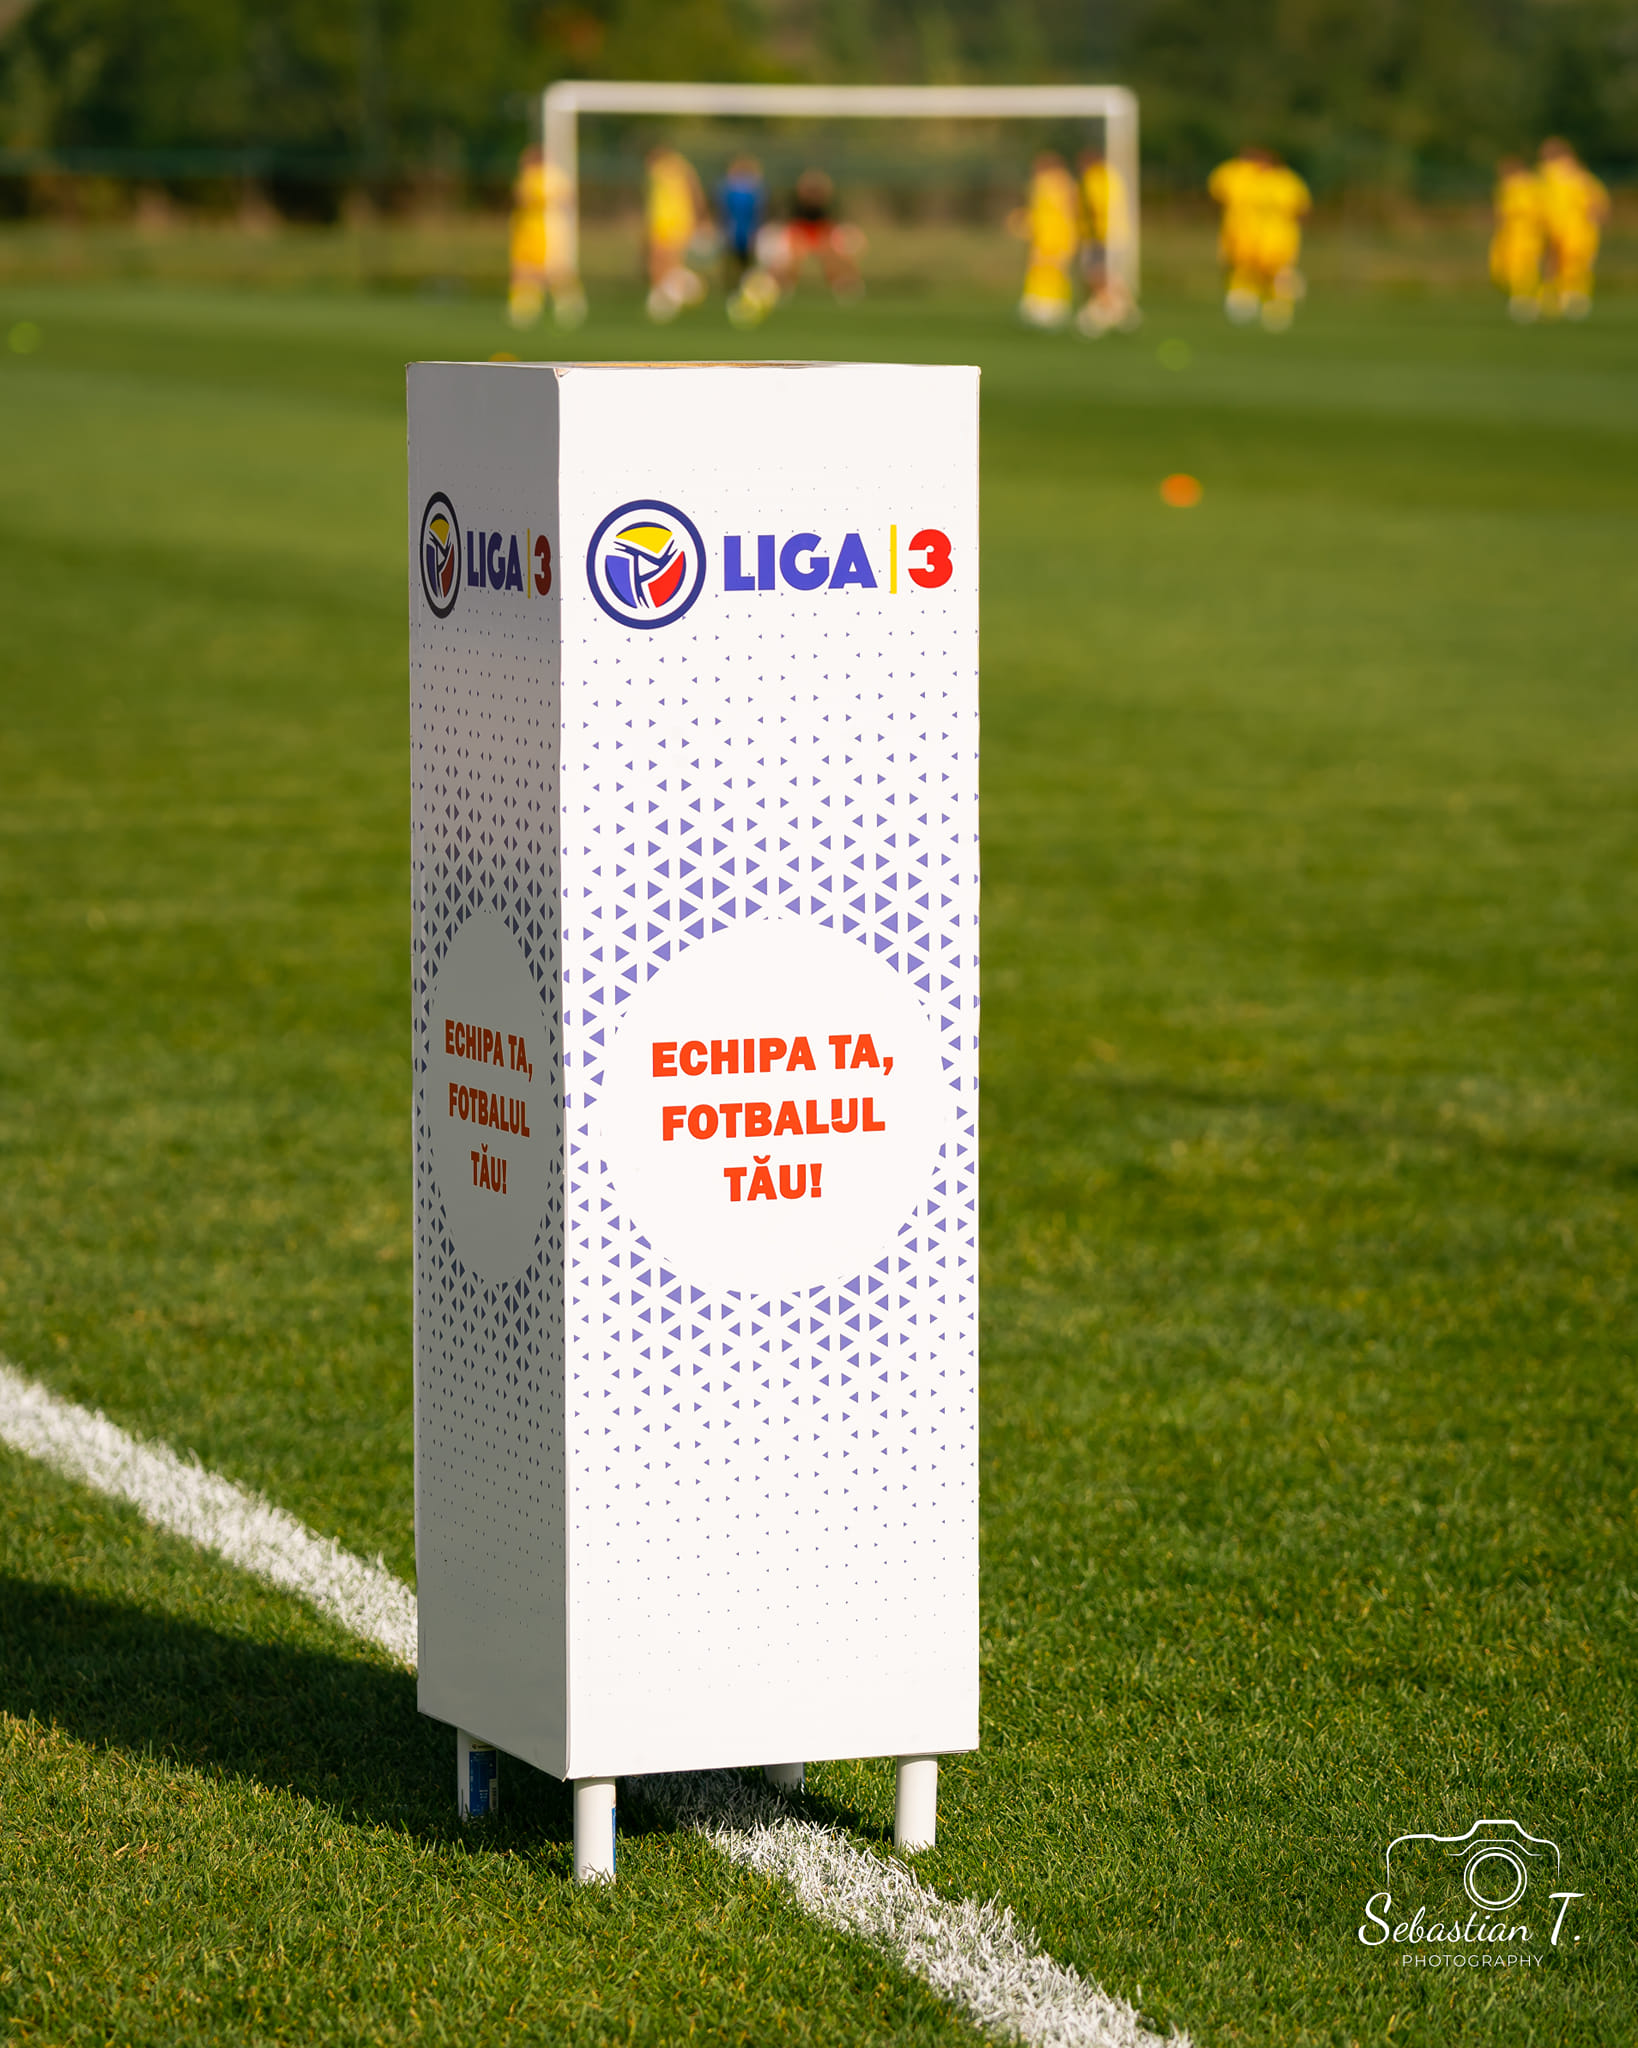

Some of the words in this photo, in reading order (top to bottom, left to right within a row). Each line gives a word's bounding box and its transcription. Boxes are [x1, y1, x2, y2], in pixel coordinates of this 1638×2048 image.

[467, 531, 524, 593] LIGA
[534, 535, 552, 597] 3
[723, 532, 878, 591] LIGA
[908, 529, 953, 588] 3
[445, 1019, 504, 1067] ECHIPA
[508, 1034, 533, 1082] TA,
[652, 1036, 816, 1077] ECHIPA
[828, 1034, 894, 1076] TA,
[449, 1083, 530, 1138] FOTBALUL
[662, 1097, 885, 1141] FOTBALUL
[471, 1143, 507, 1194] TĂU!
[724, 1155, 822, 1202] TĂU!
